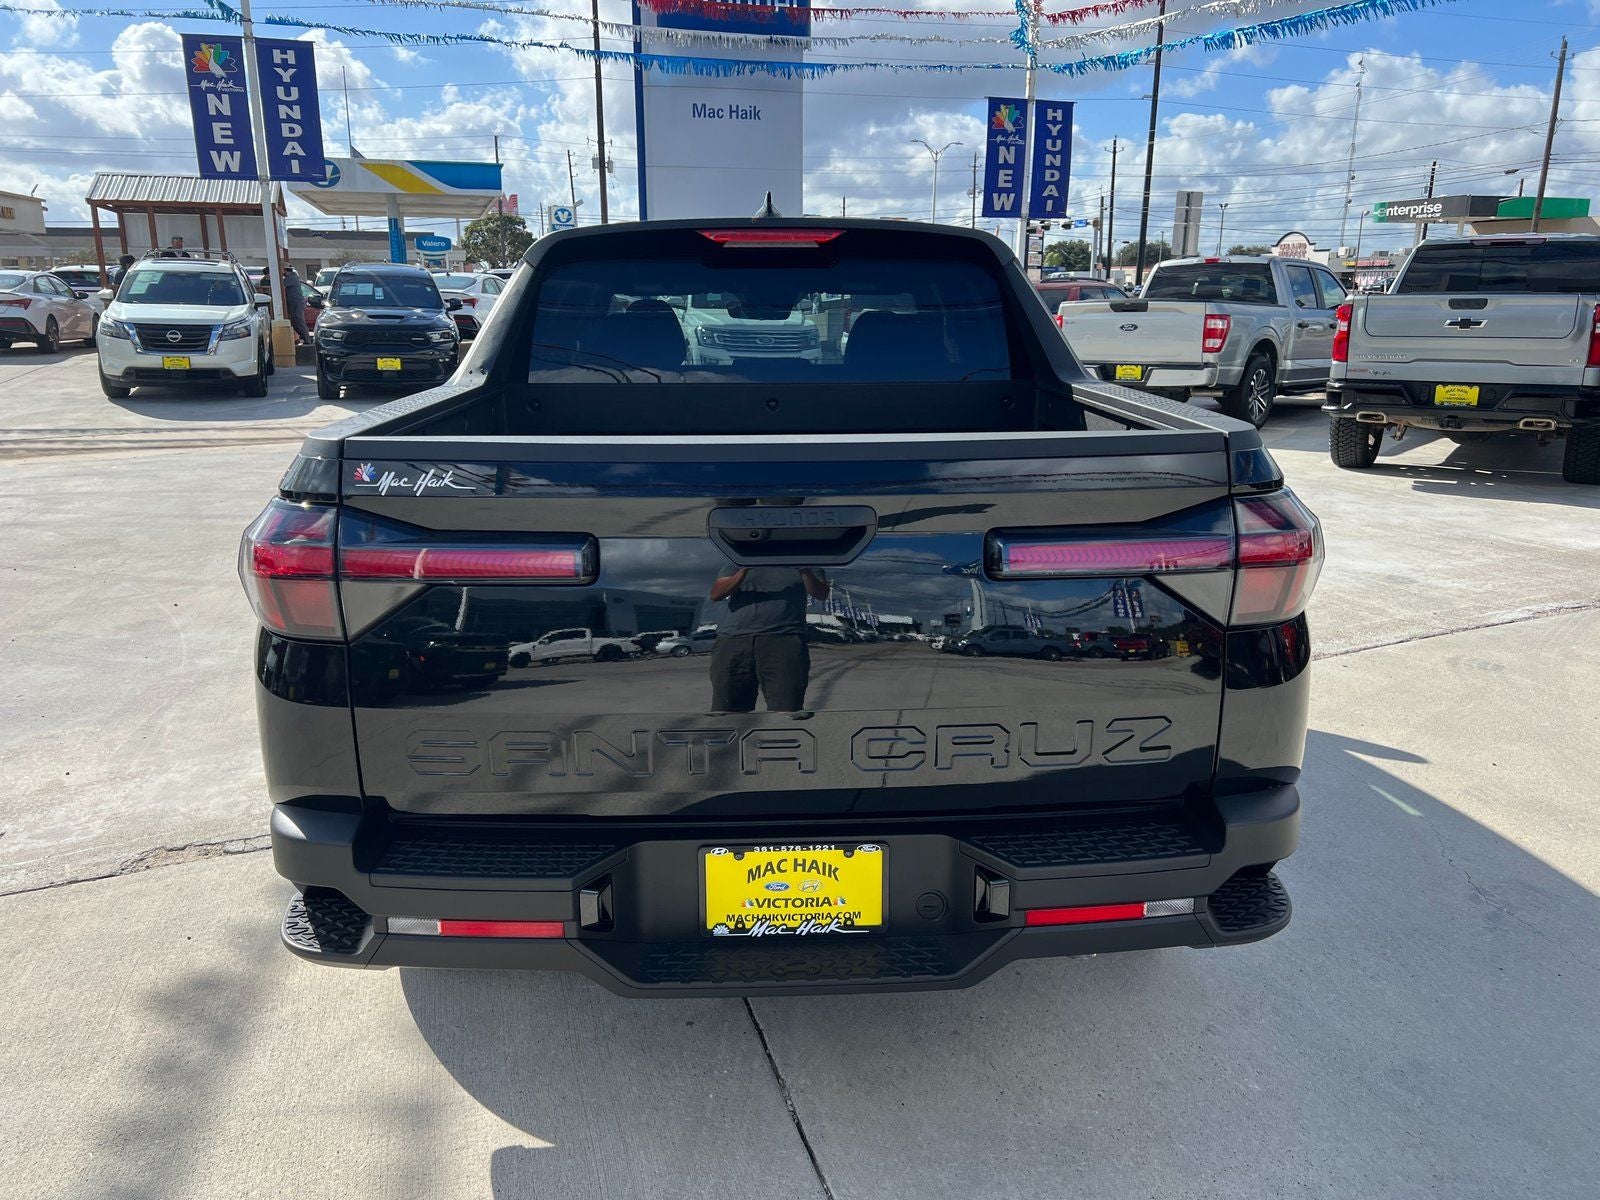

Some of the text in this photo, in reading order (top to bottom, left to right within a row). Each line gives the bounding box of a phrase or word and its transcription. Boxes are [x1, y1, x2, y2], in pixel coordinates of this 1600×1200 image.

[272, 49, 306, 174] HYUNDAI
[692, 103, 761, 121] Mac Haik
[206, 93, 241, 173] NEW
[1042, 109, 1063, 212] HYUNDAI
[992, 146, 1015, 211] NEW
[1374, 201, 1442, 218] enterprise
[421, 239, 446, 247] Valero
[370, 469, 466, 496] Mac Haik
[742, 511, 844, 526] HYUNDAI
[405, 715, 1173, 776] SANTA CRUZ
[753, 844, 836, 853] 361-576-1221
[746, 858, 840, 884] MAC HAIK
[755, 896, 833, 909] VICTORIA
[742, 918, 856, 938] Mac Haik
